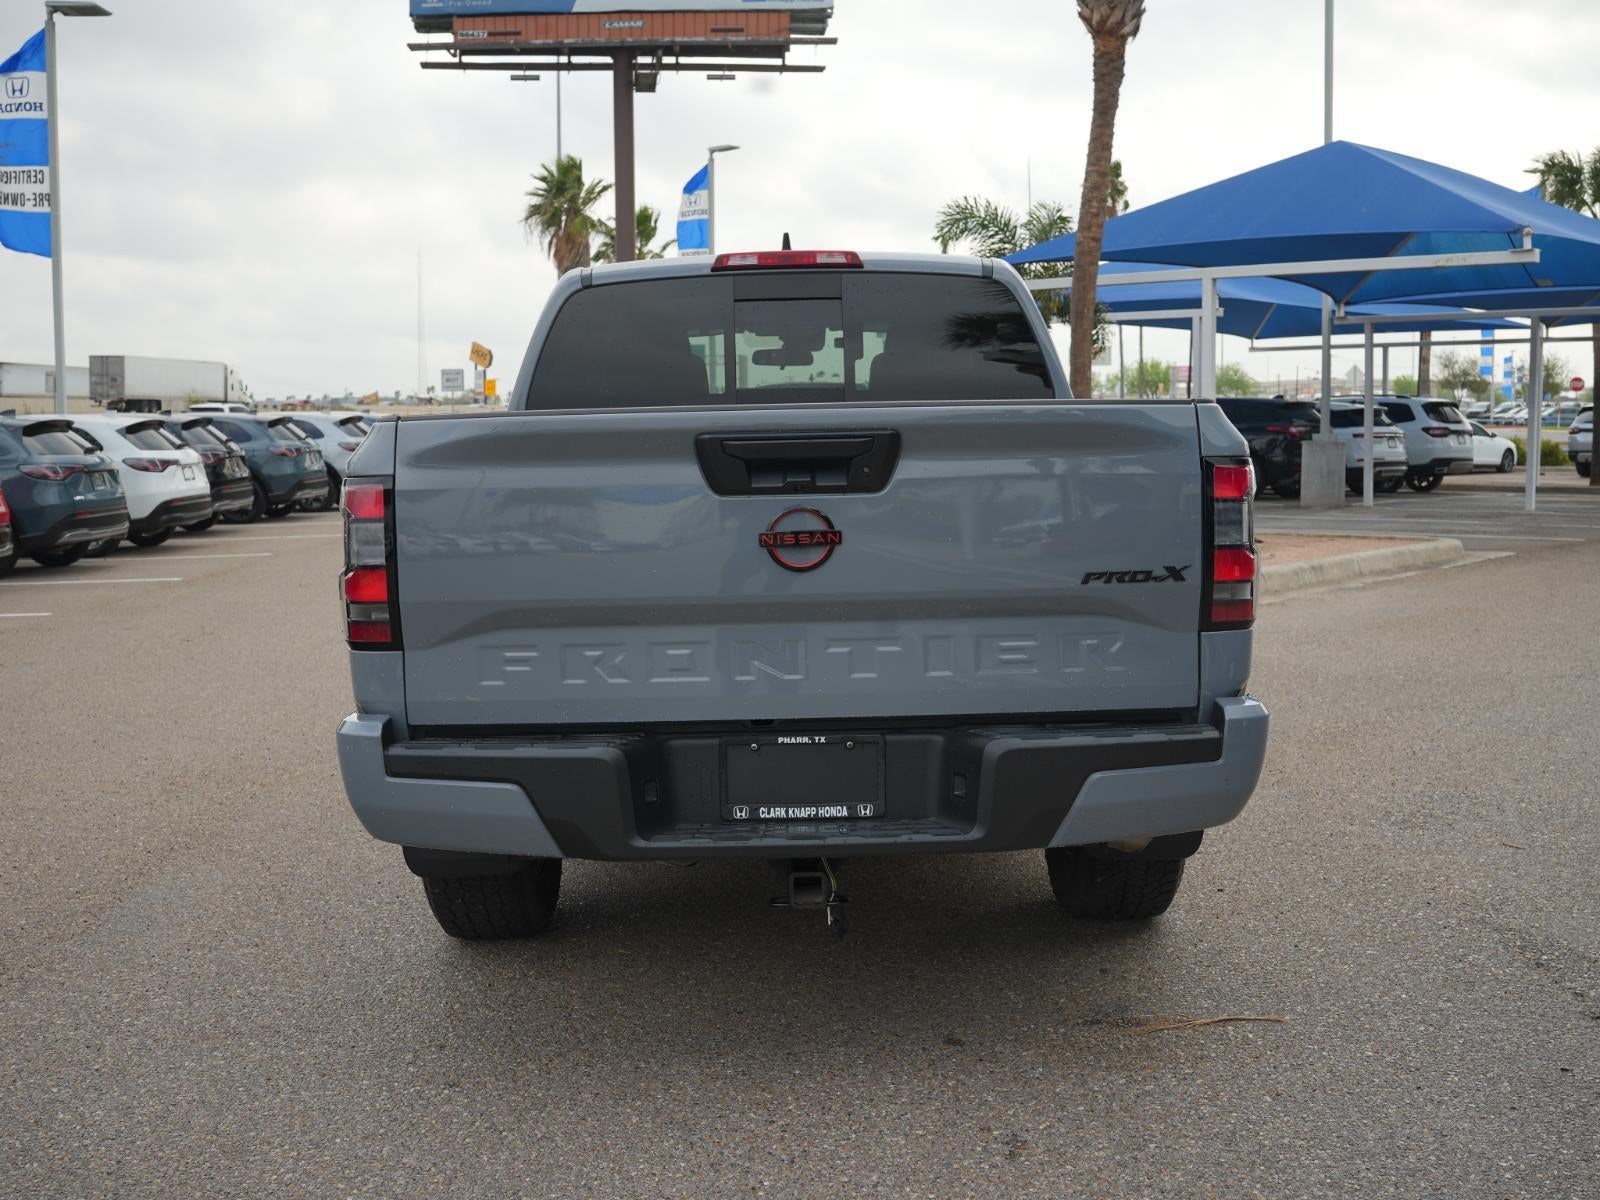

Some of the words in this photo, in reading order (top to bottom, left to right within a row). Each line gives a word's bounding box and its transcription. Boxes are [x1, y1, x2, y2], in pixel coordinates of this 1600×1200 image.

[604, 20, 645, 28] LAMAR
[760, 532, 841, 545] NISSAN
[479, 632, 1128, 687] FRONTIER
[759, 806, 787, 818] CLARK
[788, 806, 817, 818] KNAPP
[818, 805, 848, 817] HONDA
